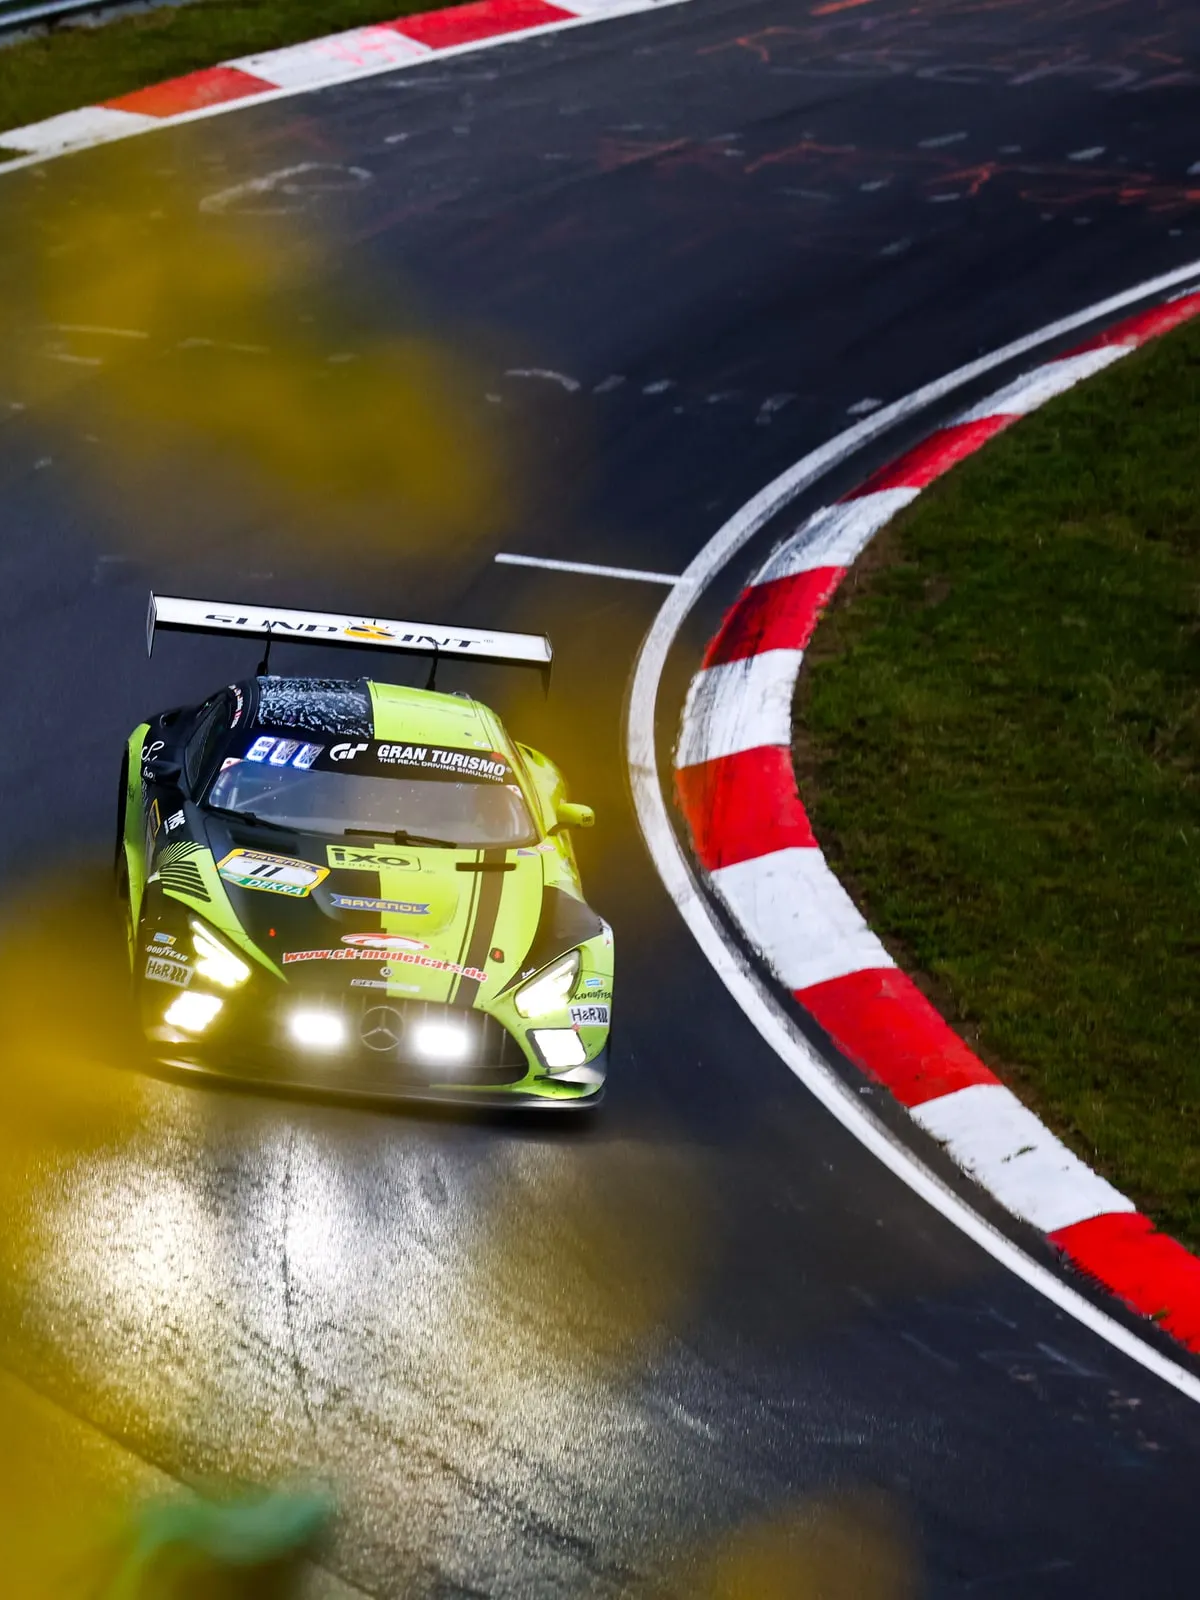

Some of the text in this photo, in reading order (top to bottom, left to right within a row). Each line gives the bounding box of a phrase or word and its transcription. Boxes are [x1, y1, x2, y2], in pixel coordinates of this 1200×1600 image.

[377, 745, 506, 777] GRAN TURISMO
[397, 758, 420, 767] REAL
[421, 761, 456, 772] DRIVING
[456, 765, 504, 783] SIMULATOR
[249, 864, 284, 878] 11
[247, 879, 304, 896] DEKRA
[340, 898, 423, 913] RAVENOL
[147, 960, 171, 978] H&R
[282, 948, 489, 982] www.ck-modelcars.de
[571, 1007, 597, 1022] H&R
